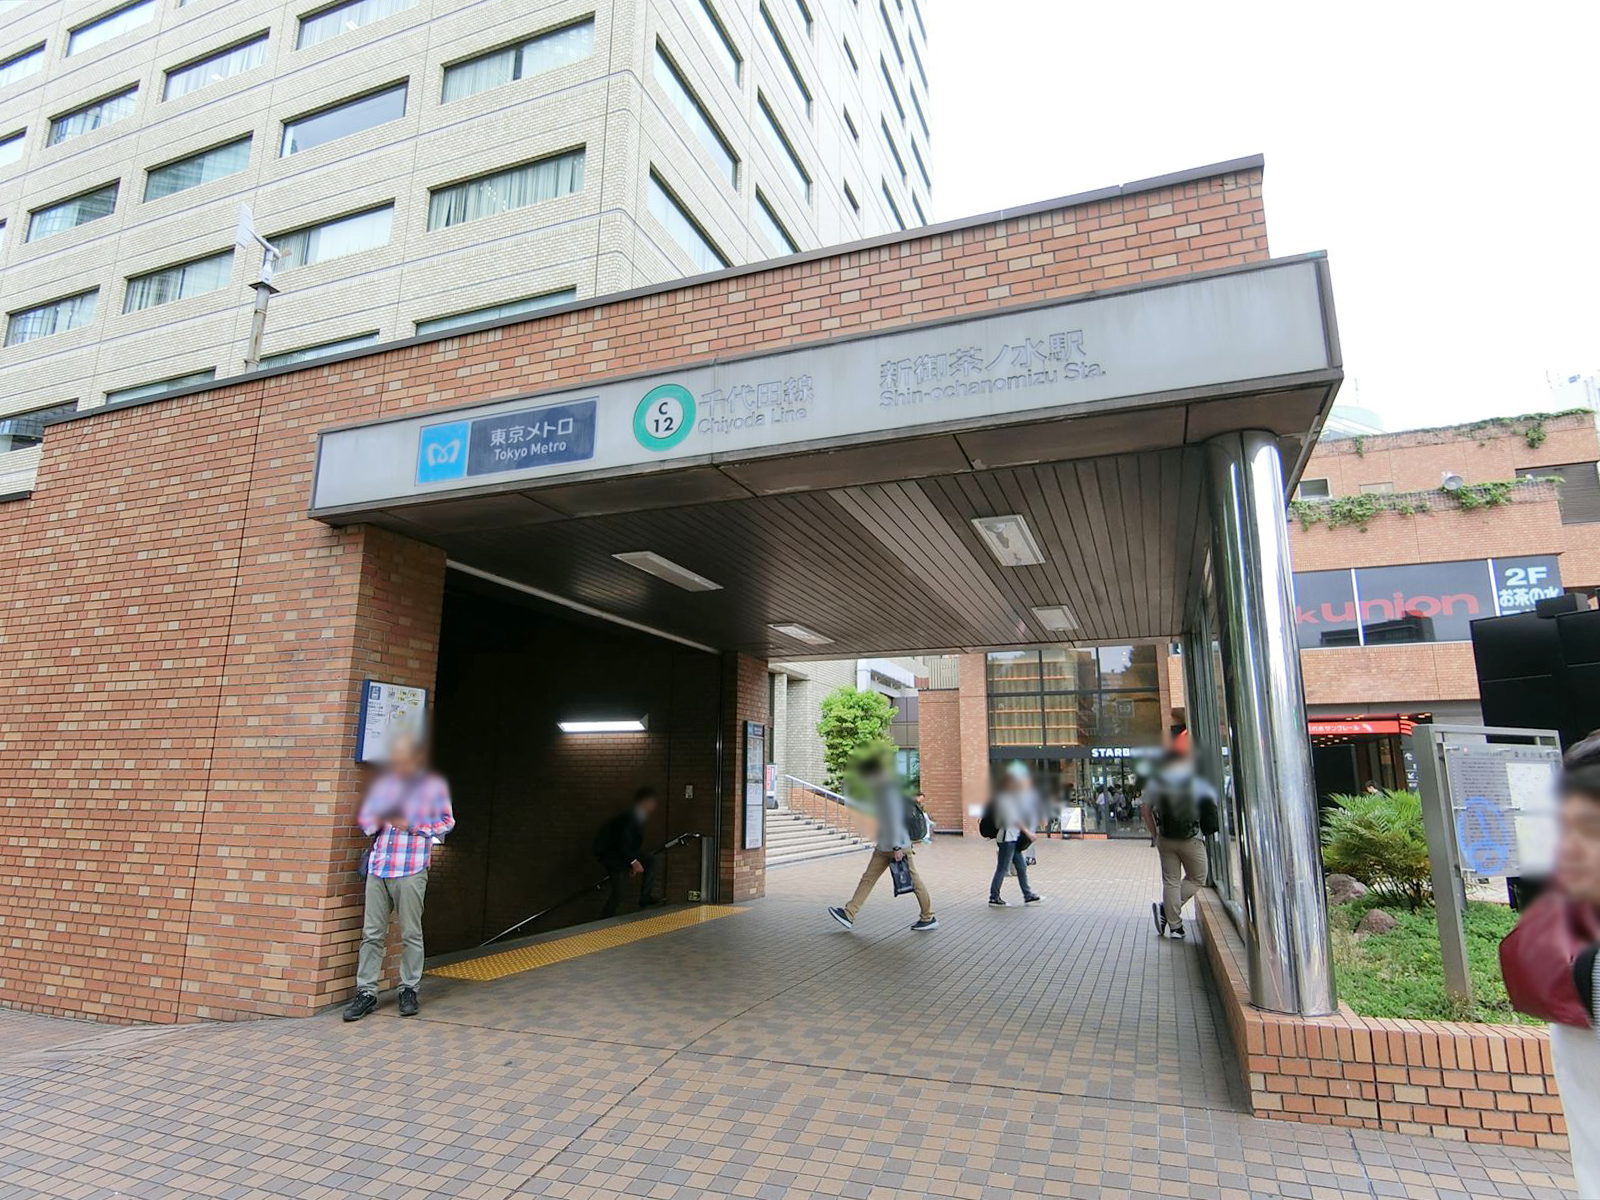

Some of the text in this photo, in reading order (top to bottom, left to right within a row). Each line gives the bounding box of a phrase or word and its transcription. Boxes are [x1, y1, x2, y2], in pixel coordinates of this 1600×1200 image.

[879, 329, 1087, 389] 新御茶ノ水駅
[698, 374, 815, 417] 千代田線
[879, 360, 1107, 407] Shin-ochanomizu Sta.
[658, 401, 669, 415] C
[697, 406, 808, 435] Chiyoda Line
[489, 417, 574, 447] 東京メトロ
[653, 416, 674, 433] 12
[494, 441, 567, 461] Tokyo Metro
[1504, 566, 1548, 586] 2F
